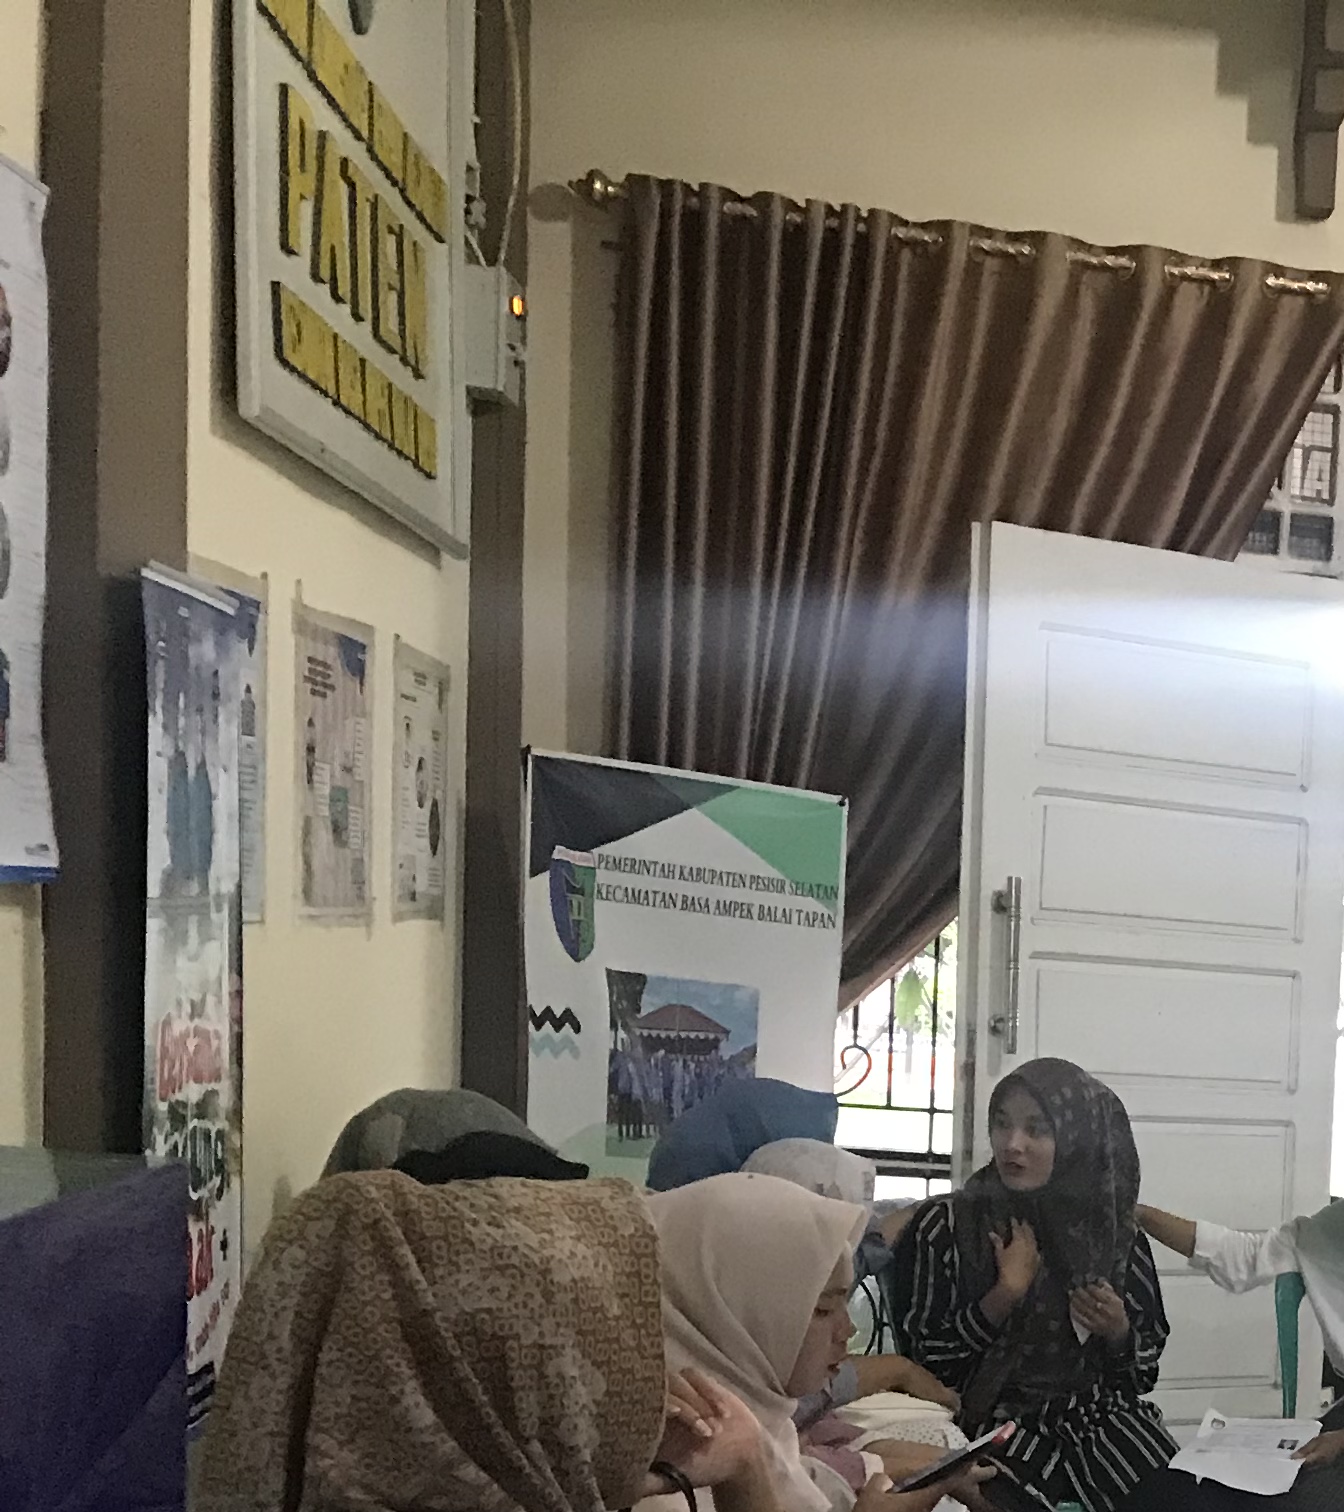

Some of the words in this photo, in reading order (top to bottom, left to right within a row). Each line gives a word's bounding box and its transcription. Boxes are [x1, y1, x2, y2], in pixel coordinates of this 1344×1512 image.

[278, 82, 428, 380] PATEN
[597, 852, 675, 881] PEMERINTAH
[677, 864, 748, 890] KABUPATEN
[749, 873, 787, 895] PESISIR
[788, 879, 839, 901] SELATAN
[595, 882, 679, 911] KECAMATAN
[679, 893, 711, 916] BASA
[713, 899, 755, 921] AMPEK
[756, 903, 793, 925] BALAI
[796, 908, 837, 930] TAPAN
